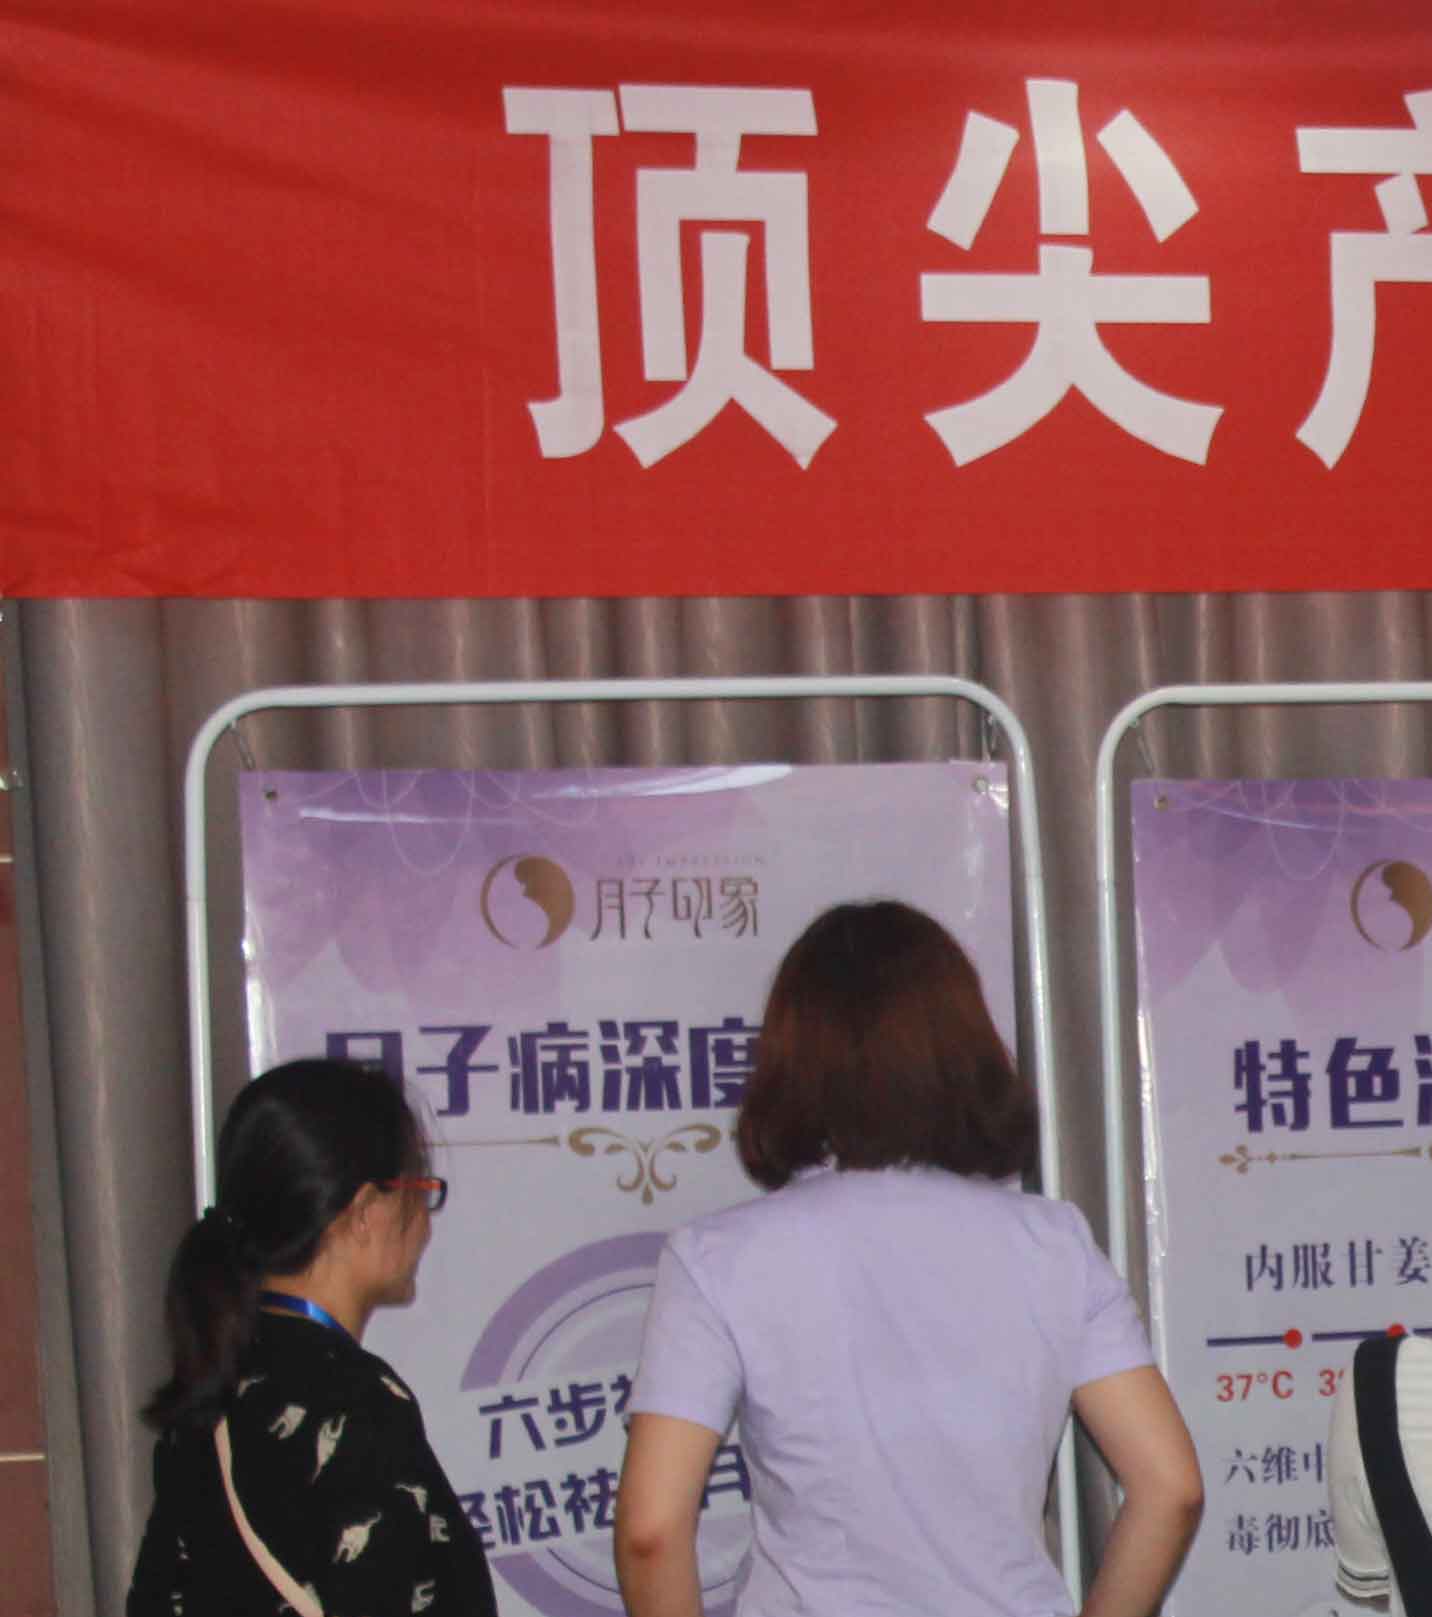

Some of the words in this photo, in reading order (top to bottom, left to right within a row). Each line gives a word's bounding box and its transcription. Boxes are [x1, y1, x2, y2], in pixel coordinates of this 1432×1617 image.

[589, 876, 760, 940] 月子印象
[1215, 1370, 1296, 1403] 37°C
[1318, 1368, 1345, 1398] 3
